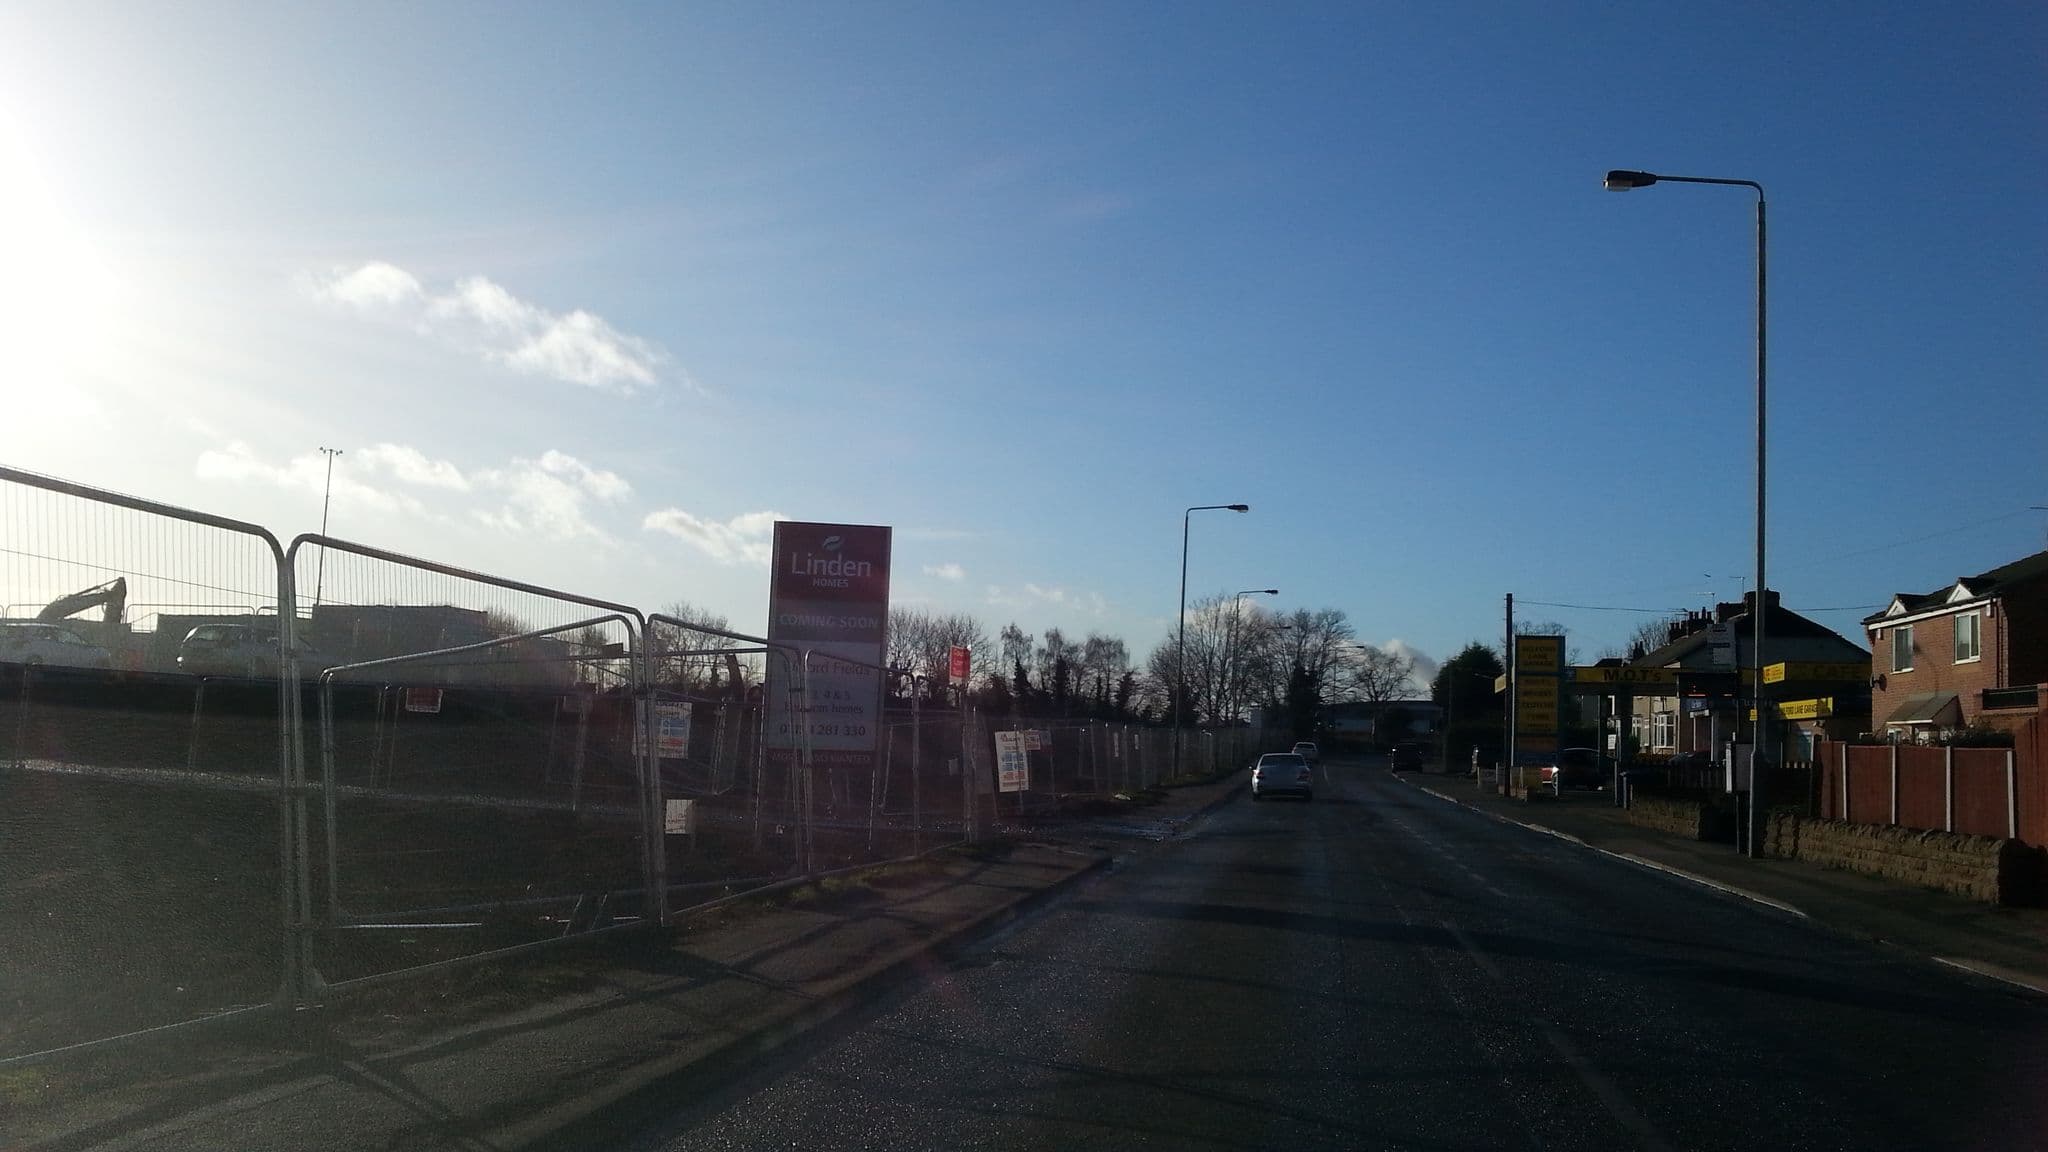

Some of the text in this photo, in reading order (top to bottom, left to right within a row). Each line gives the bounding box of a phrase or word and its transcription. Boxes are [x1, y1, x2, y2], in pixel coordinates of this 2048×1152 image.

[791, 552, 871, 577] Linden
[813, 578, 849, 588] HOMES
[779, 614, 879, 629] COMING SOON
[815, 723, 840, 734] 281
[844, 725, 866, 735] 330
